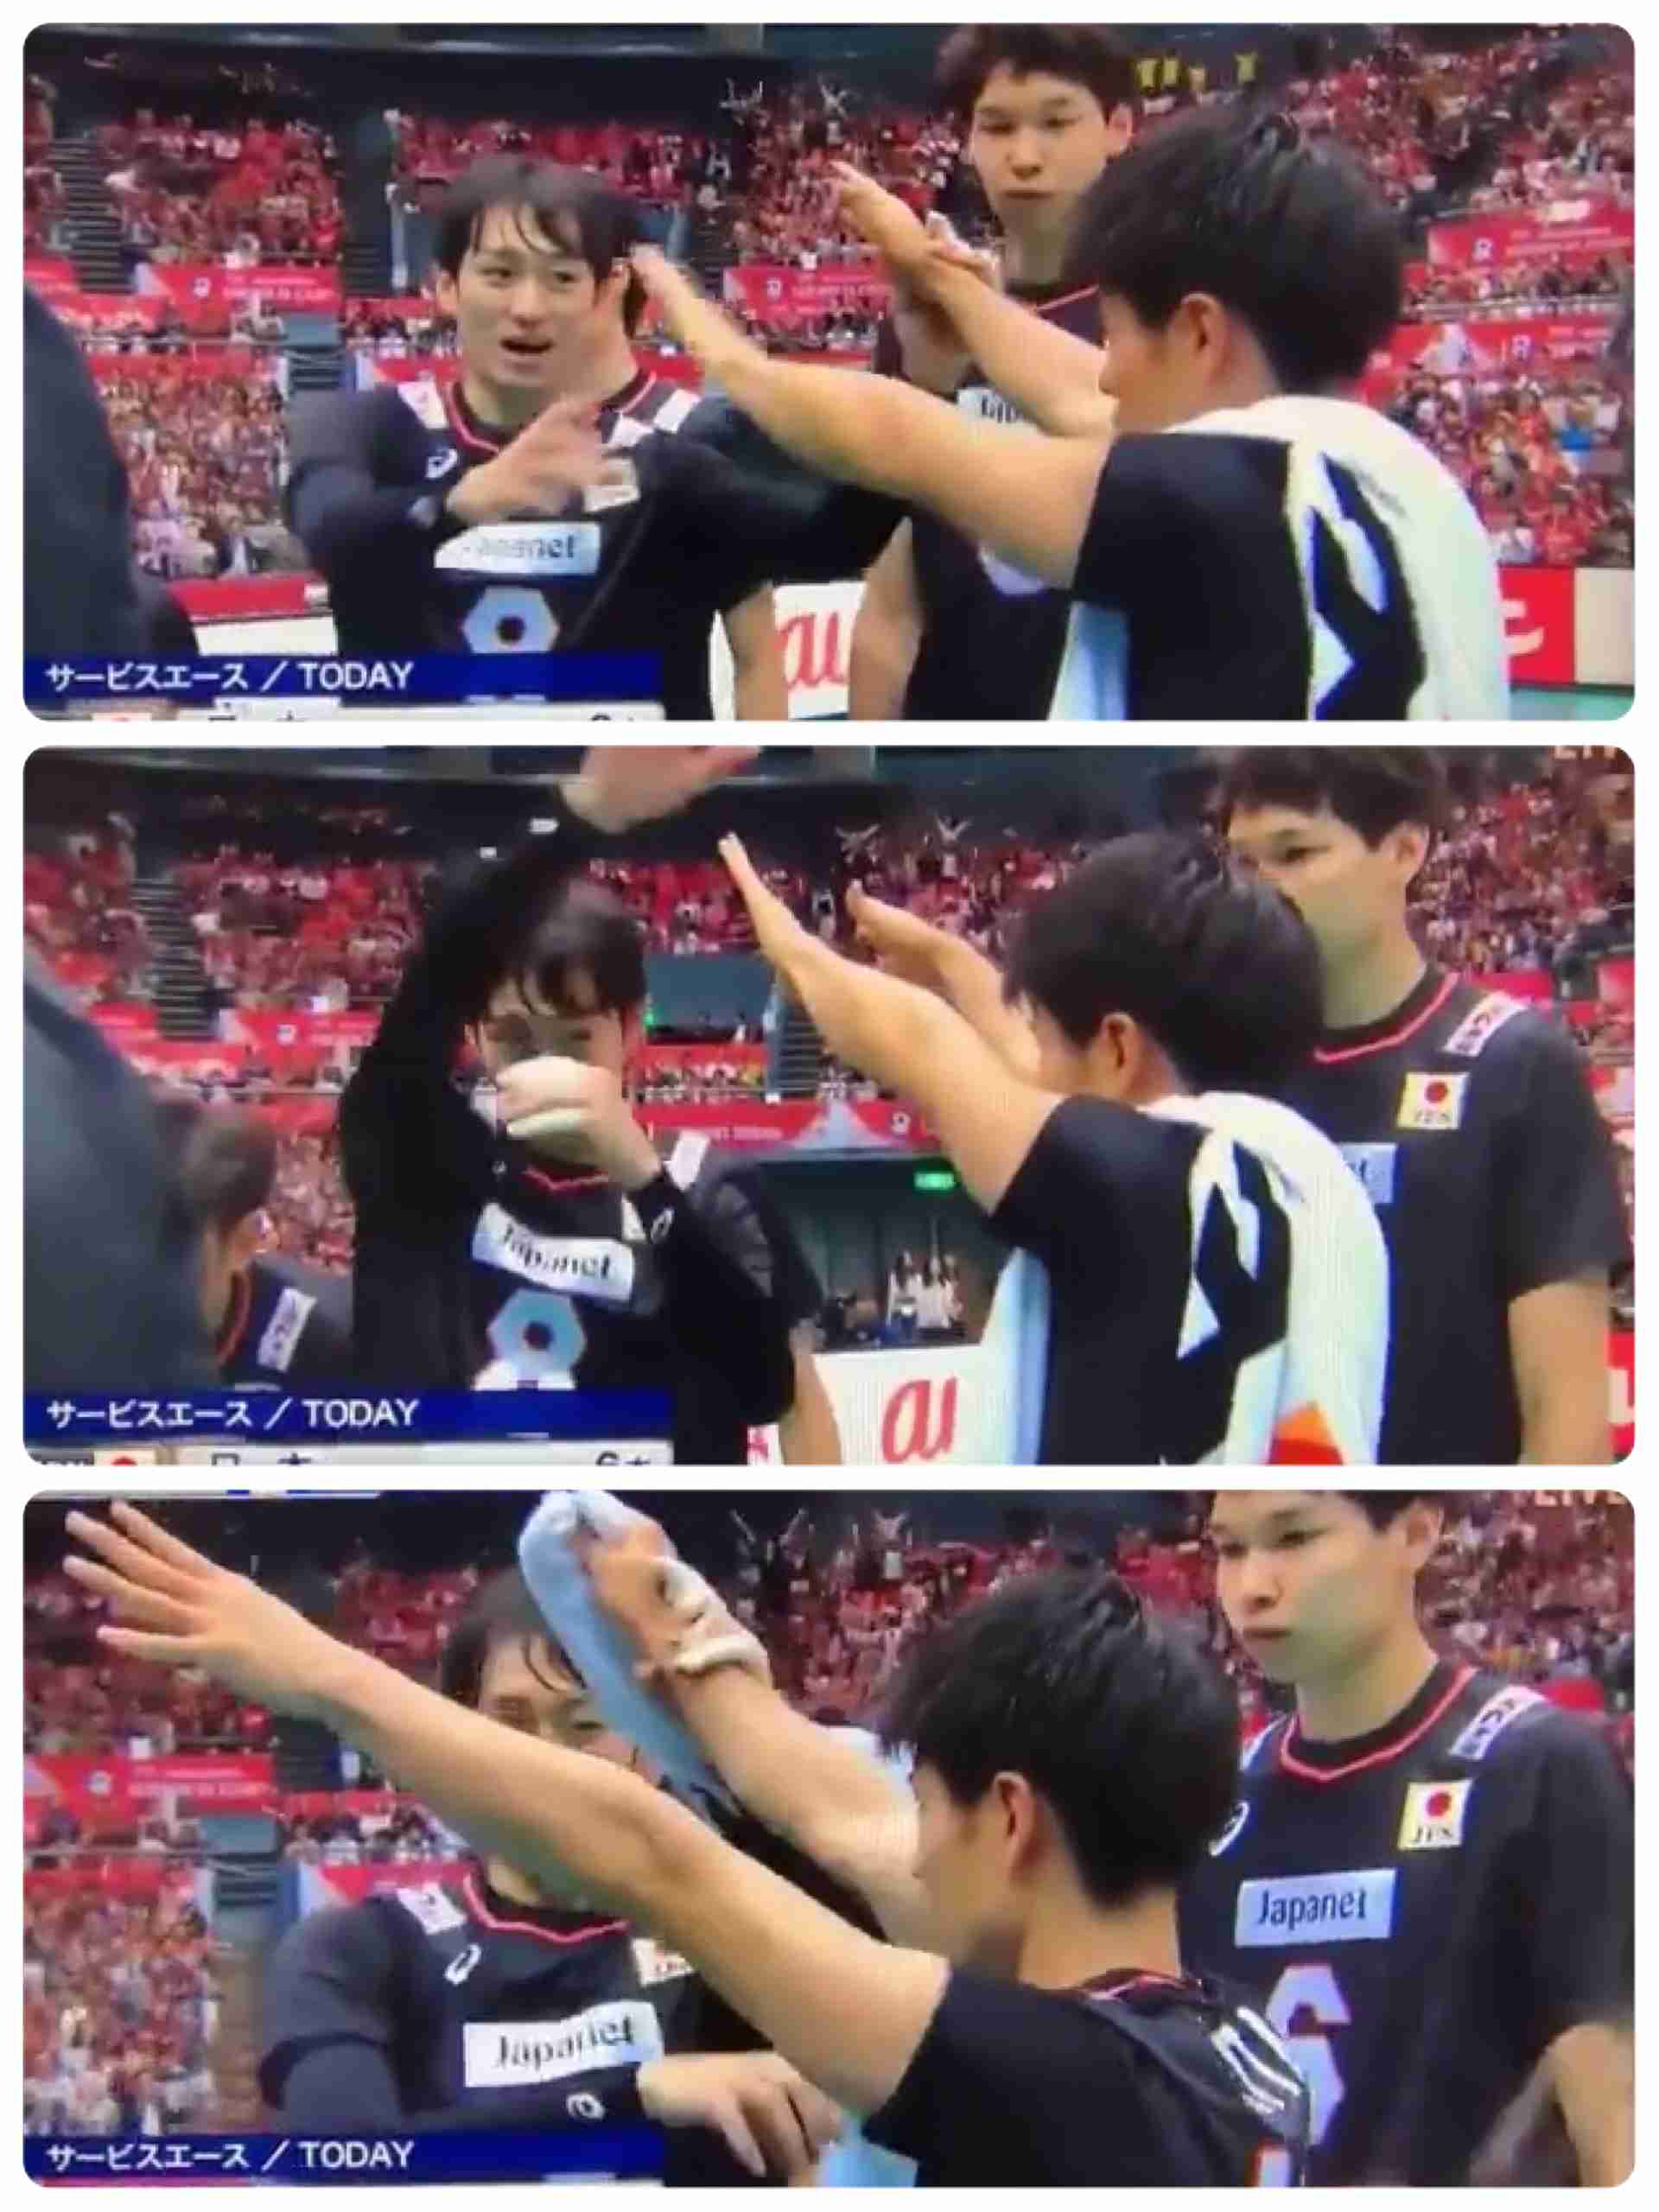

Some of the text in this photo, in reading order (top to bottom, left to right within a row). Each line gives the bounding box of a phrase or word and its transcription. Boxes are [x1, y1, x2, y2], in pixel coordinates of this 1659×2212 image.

[45, 661, 249, 691] サービスエース
[296, 662, 414, 690] TODAY
[46, 1398, 252, 1428] サービスエース
[301, 1398, 420, 1427] TODAY
[881, 1376, 957, 1465] au
[1257, 1887, 1367, 1931] Japanet
[492, 2016, 633, 2072] Japanet
[46, 2142, 250, 2171] サービスエース
[297, 2141, 415, 2170] TODAY
